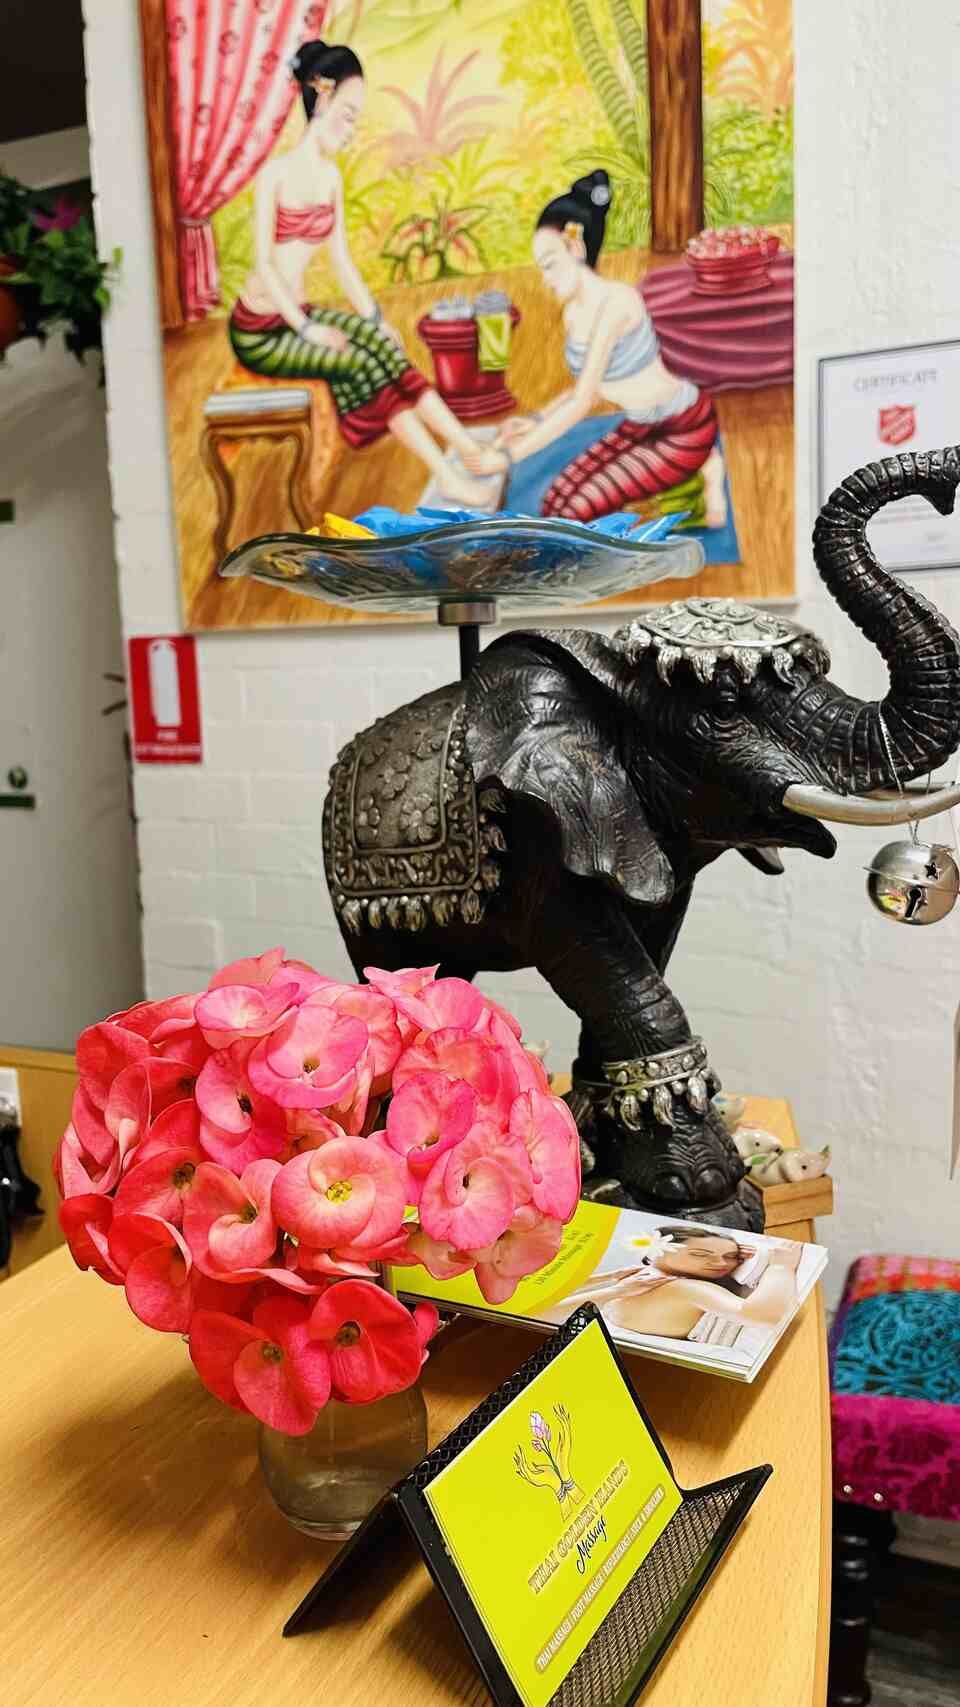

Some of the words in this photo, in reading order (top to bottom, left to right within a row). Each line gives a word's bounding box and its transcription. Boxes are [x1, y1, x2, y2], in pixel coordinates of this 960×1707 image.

[852, 369, 938, 393] CERTIFICATE
[527, 1551, 561, 1594] THAI
[555, 1501, 599, 1558] GOLDEN
[593, 1459, 629, 1509] HANDS
[576, 1516, 607, 1575] Massage
